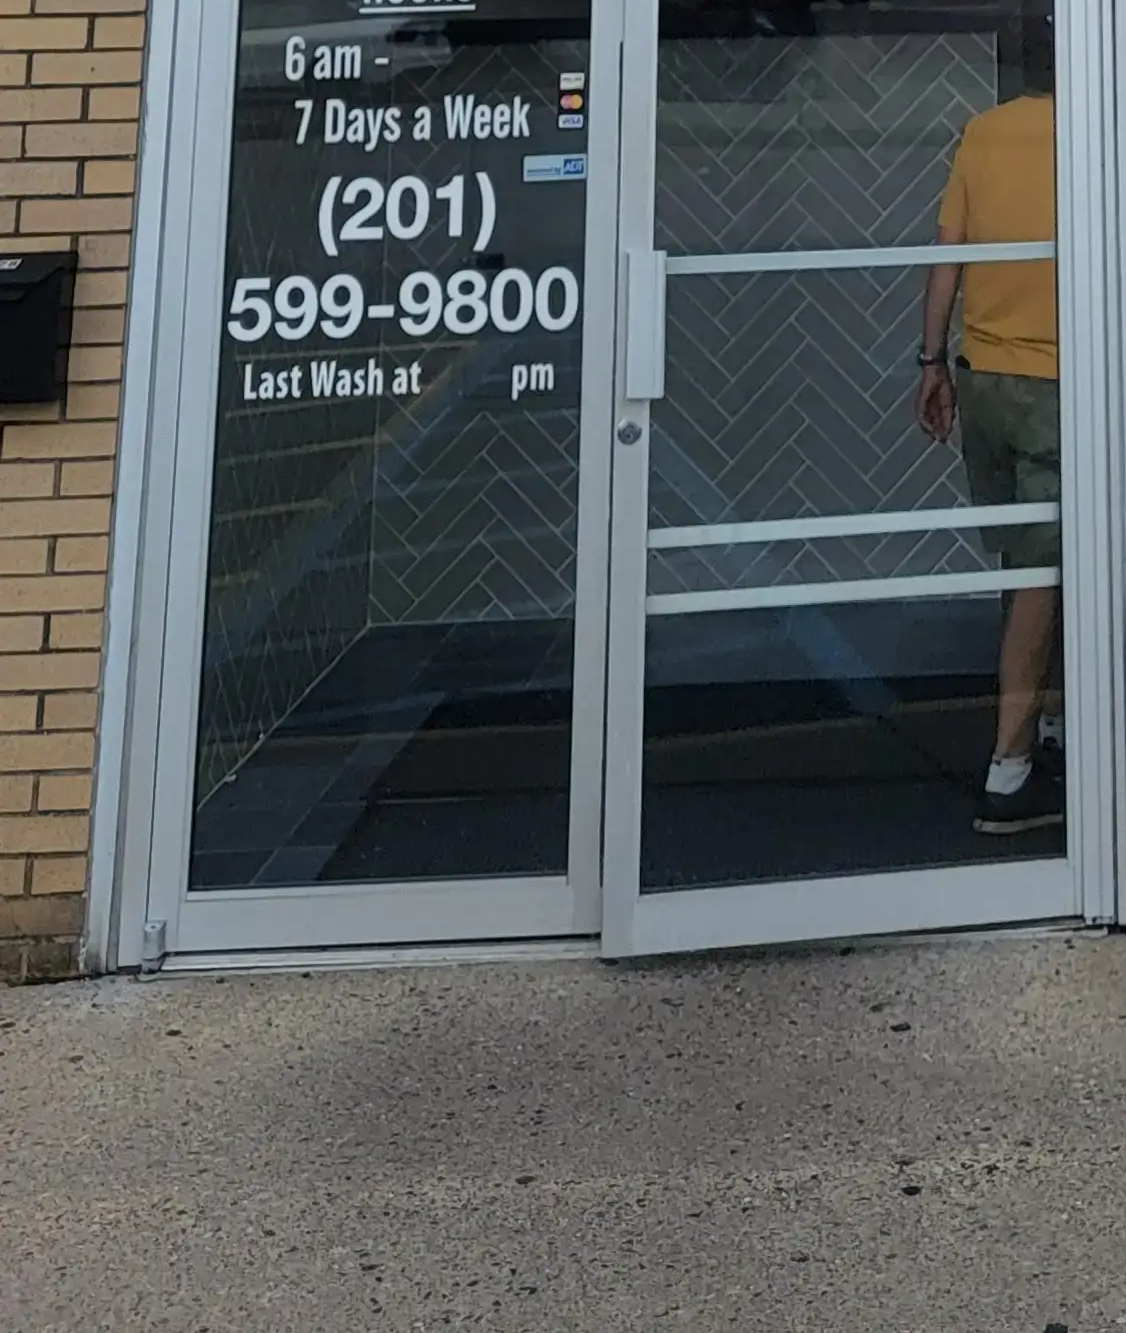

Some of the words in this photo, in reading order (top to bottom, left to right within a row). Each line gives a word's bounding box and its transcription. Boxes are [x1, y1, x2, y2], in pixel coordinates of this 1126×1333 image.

[285, 36, 305, 81] 6
[313, 43, 361, 80] am
[295, 99, 313, 145] 7
[324, 99, 401, 151] Days
[412, 105, 431, 140] a
[443, 94, 531, 139] Week
[318, 171, 496, 256] (201)
[227, 266, 579, 343] 599-9800
[243, 364, 302, 401] Last
[311, 358, 384, 397] Wash
[392, 360, 421, 394] at
[512, 362, 554, 401] pm
